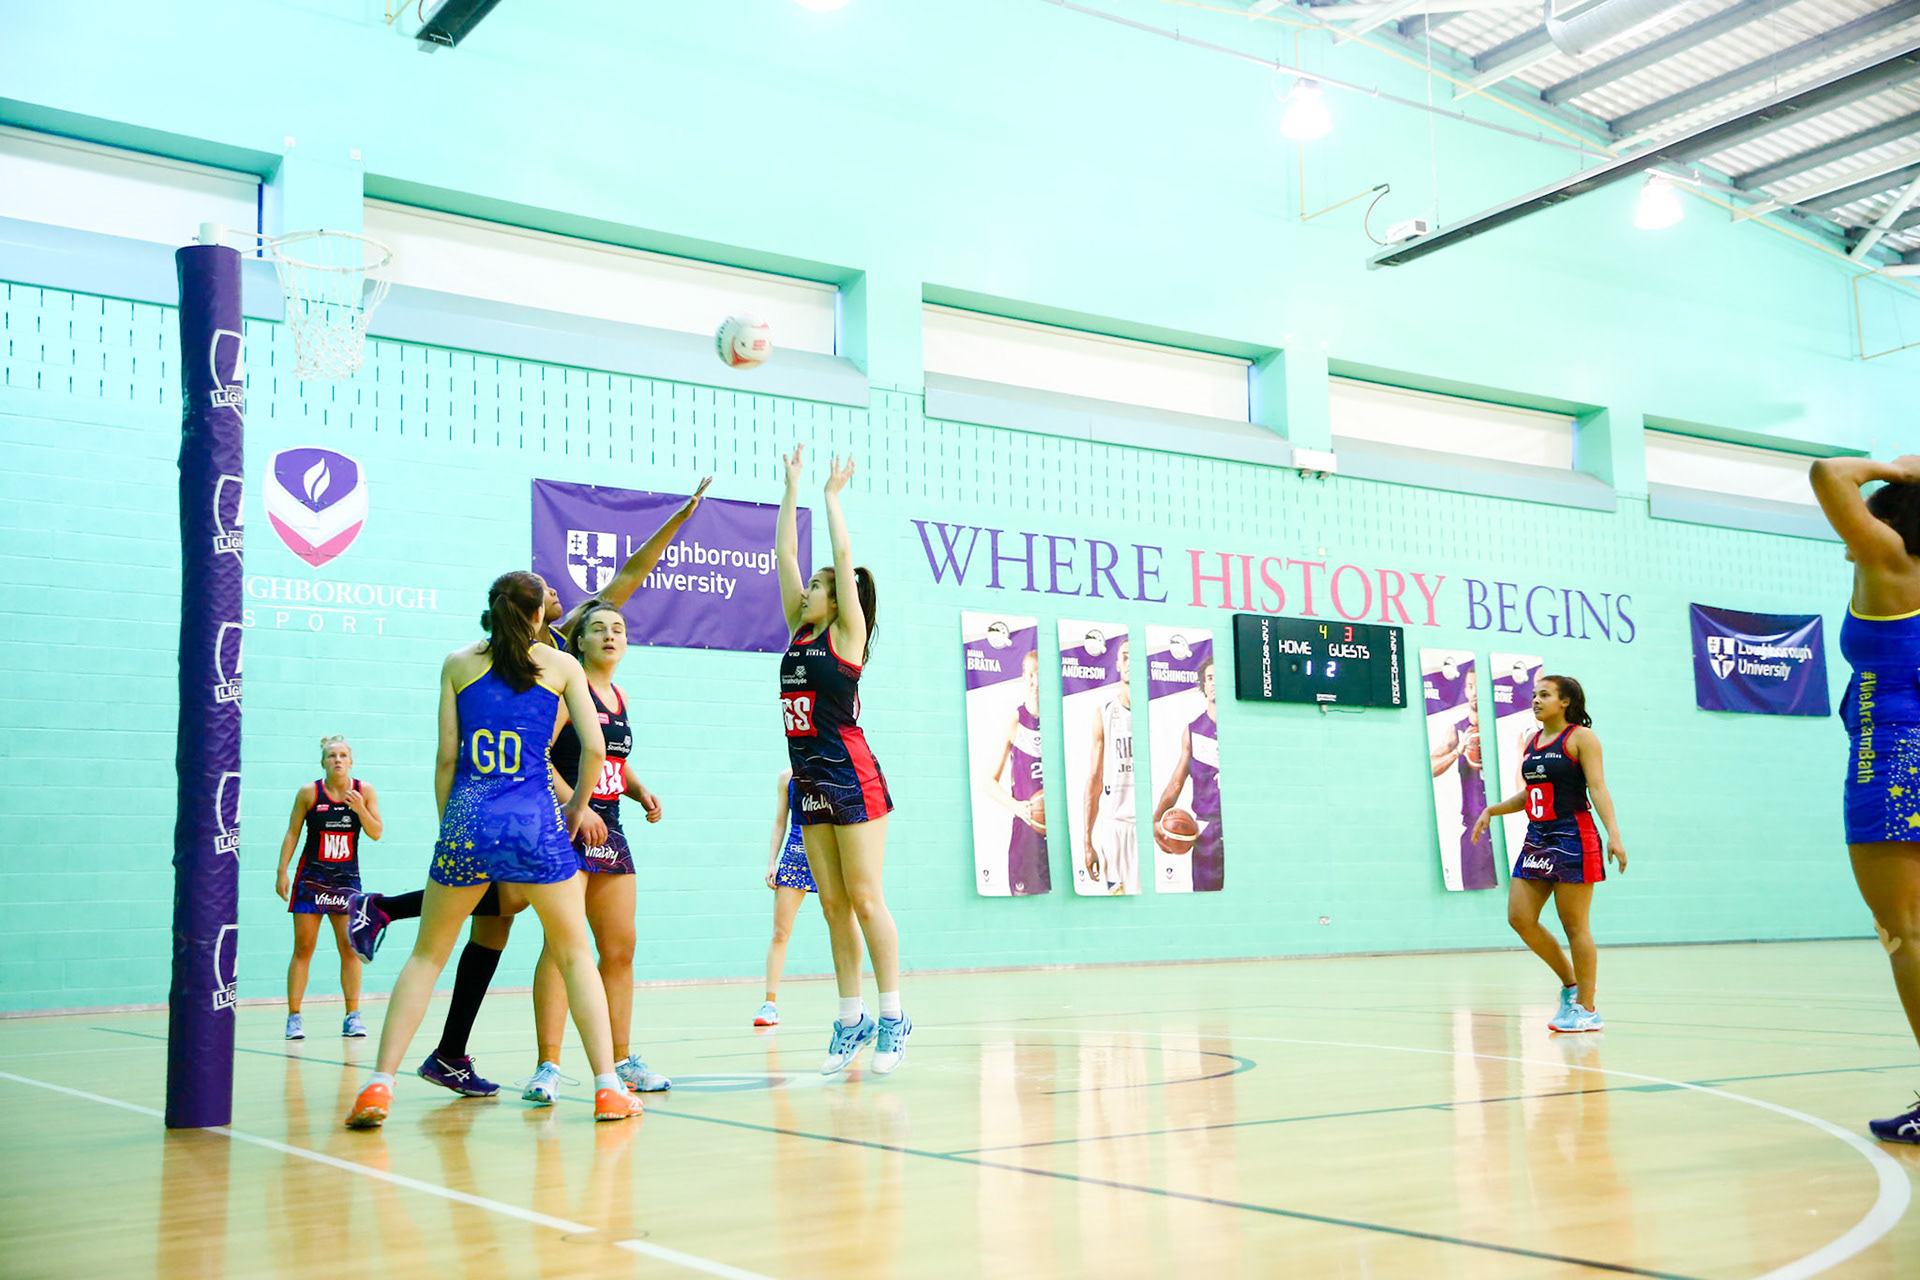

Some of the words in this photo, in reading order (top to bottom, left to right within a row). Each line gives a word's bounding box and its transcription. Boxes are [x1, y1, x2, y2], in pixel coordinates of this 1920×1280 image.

[626, 535, 779, 575] Lghborough
[243, 576, 438, 610] GHBOROUGH
[642, 567, 737, 600] niversity
[910, 519, 1168, 603] WHERE
[1185, 549, 1447, 628] HISTORY
[1463, 578, 1636, 644] BEGINS
[242, 609, 388, 635] SPORT
[1319, 624, 1328, 640] 4
[1344, 626, 1354, 642] 3
[1279, 640, 1312, 655] HOME
[1329, 643, 1370, 659] GUESTS
[1737, 642, 1812, 663] Loughborough
[967, 657, 1001, 673] BRATKA
[1061, 664, 1106, 680] ANDERSON
[1305, 660, 1313, 676] 1
[1326, 661, 1337, 677] 2
[1738, 659, 1791, 681] University
[472, 728, 522, 774] GD
[1530, 787, 1544, 819] C
[324, 833, 350, 859] WA
[582, 841, 619, 865] Vitality
[1522, 854, 1554, 875] Vitality
[315, 892, 350, 910] Vitality
